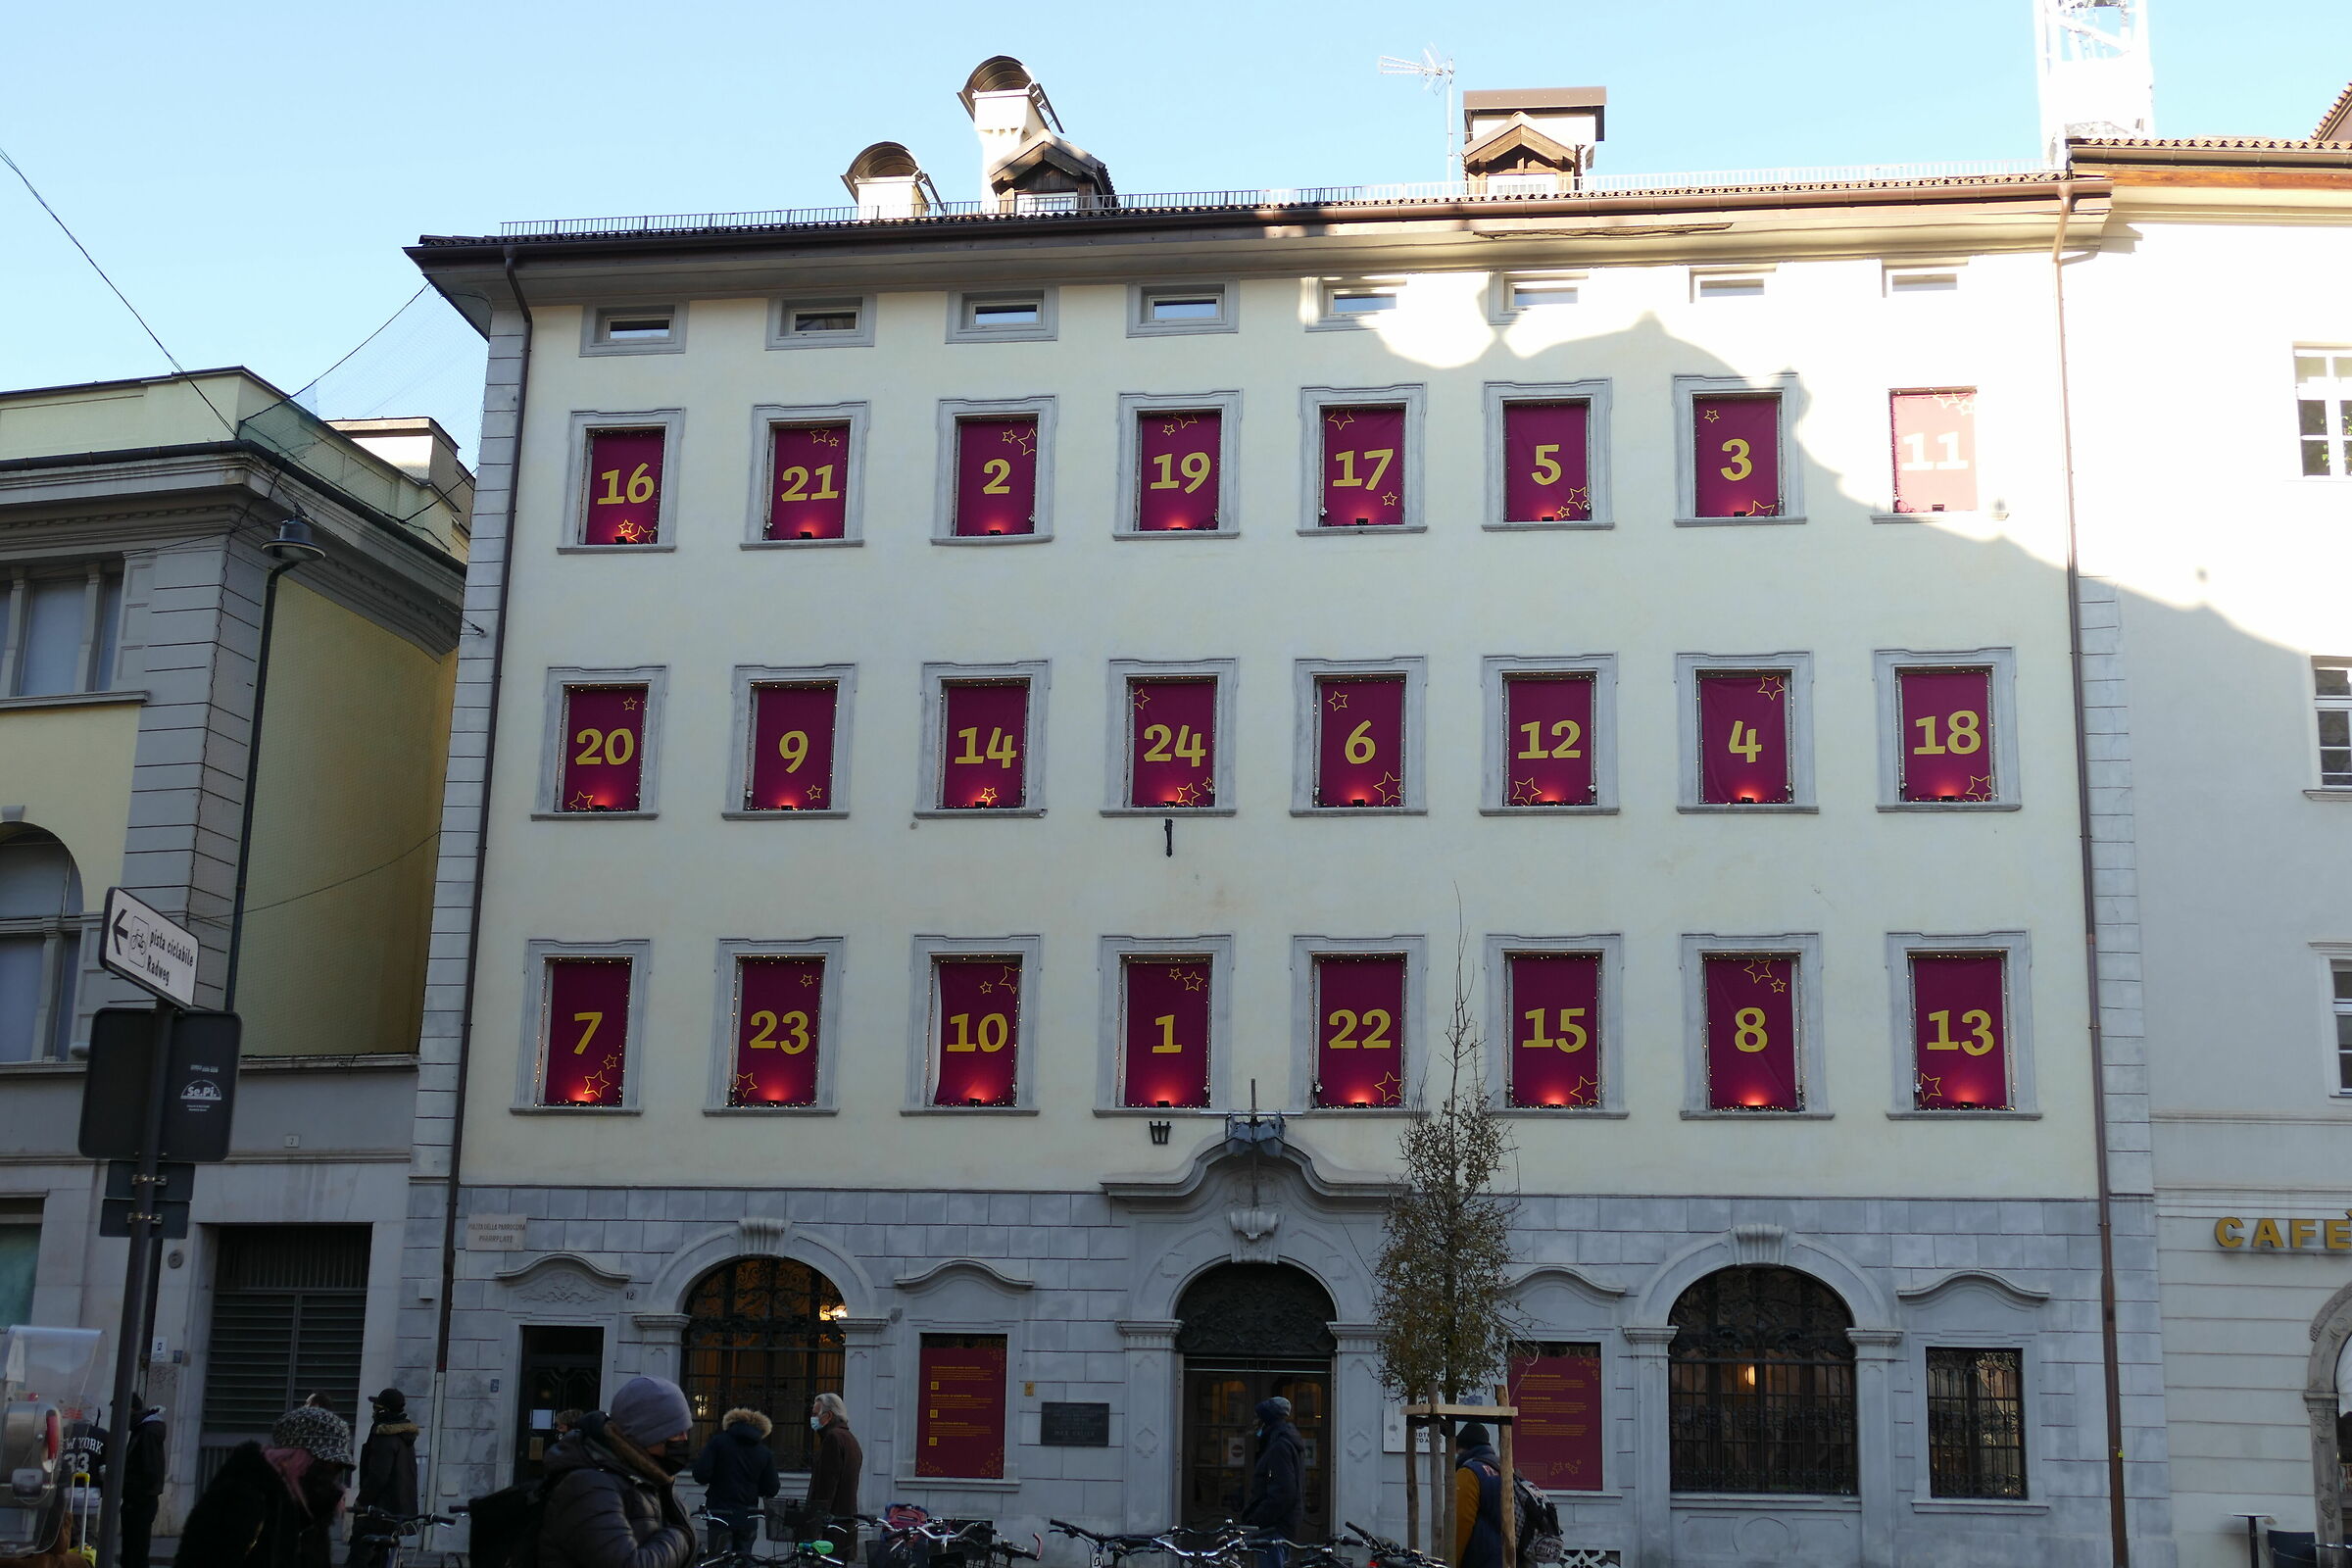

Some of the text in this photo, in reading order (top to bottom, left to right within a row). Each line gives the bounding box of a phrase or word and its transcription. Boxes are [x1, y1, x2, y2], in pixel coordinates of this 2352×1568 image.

[1334, 449, 1392, 489] 17
[1534, 445, 1559, 484] 5
[1723, 439, 1752, 479] 3
[1901, 431, 1969, 470] 11
[598, 465, 654, 504] 16
[782, 466, 837, 501] 21
[985, 460, 1008, 493] 2
[1152, 454, 1211, 492] 19
[576, 729, 633, 764] 20
[780, 731, 808, 772] 9
[956, 727, 1015, 768] 14
[1146, 725, 1204, 766] 24
[1347, 721, 1375, 763] 6
[1520, 721, 1580, 759] 12
[1731, 721, 1762, 761] 4
[1917, 711, 1981, 754] 18
[149, 929, 194, 967] pista ciclabile
[147, 955, 170, 987] Radweg
[575, 1012, 602, 1054] 7
[750, 1011, 808, 1054] 23
[947, 1013, 1007, 1052] 10
[1153, 1015, 1182, 1053] 1
[1329, 1009, 1391, 1049] 22
[1524, 1008, 1587, 1053] 15
[1737, 1007, 1767, 1052] 8
[1929, 1009, 1994, 1055] 13
[626, 1292, 635, 1300] 12
[64, 1452, 89, 1474] 33
[77, 1437, 104, 1455] YORK
